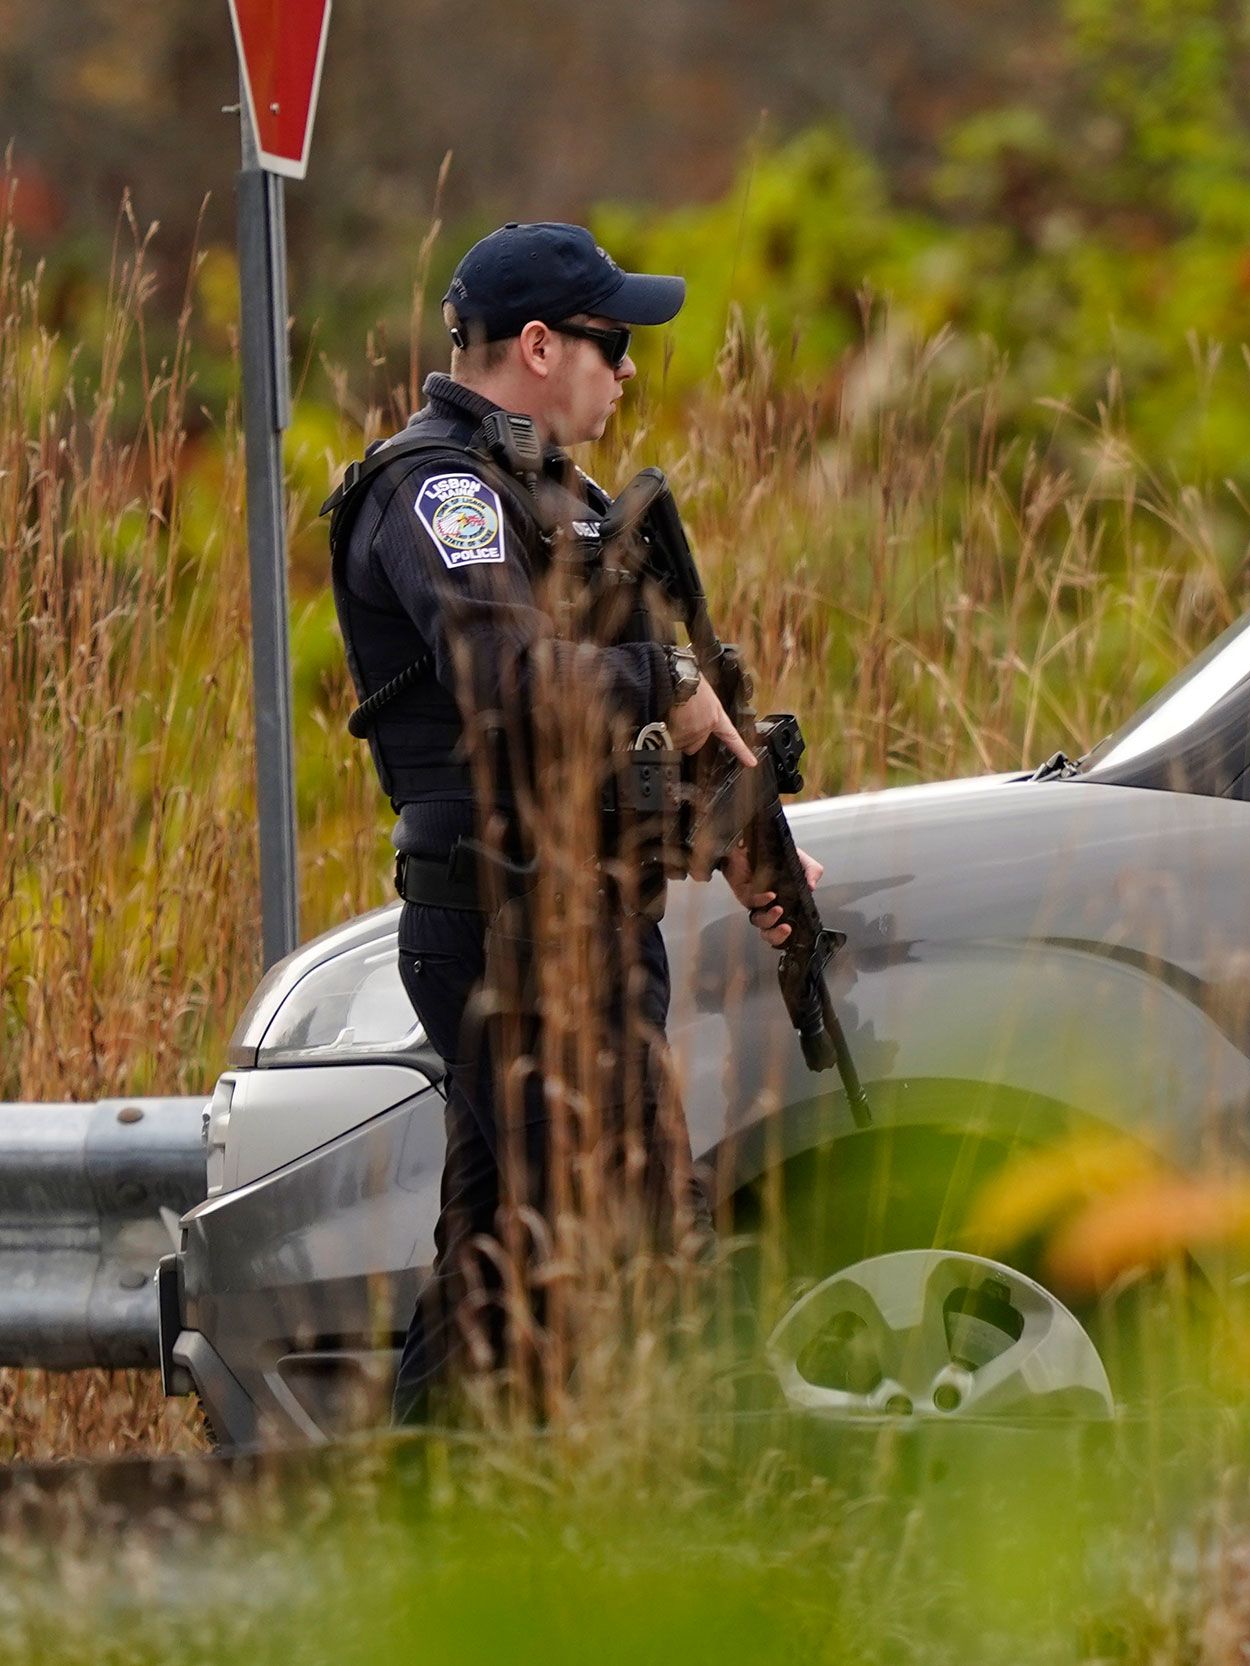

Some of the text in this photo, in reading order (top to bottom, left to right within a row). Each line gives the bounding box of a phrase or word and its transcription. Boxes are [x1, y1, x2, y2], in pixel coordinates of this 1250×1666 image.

[425, 479, 480, 499] LISBON
[438, 489, 475, 501] MAINE
[443, 535, 464, 546] STATE
[450, 547, 500, 563] POLICE
